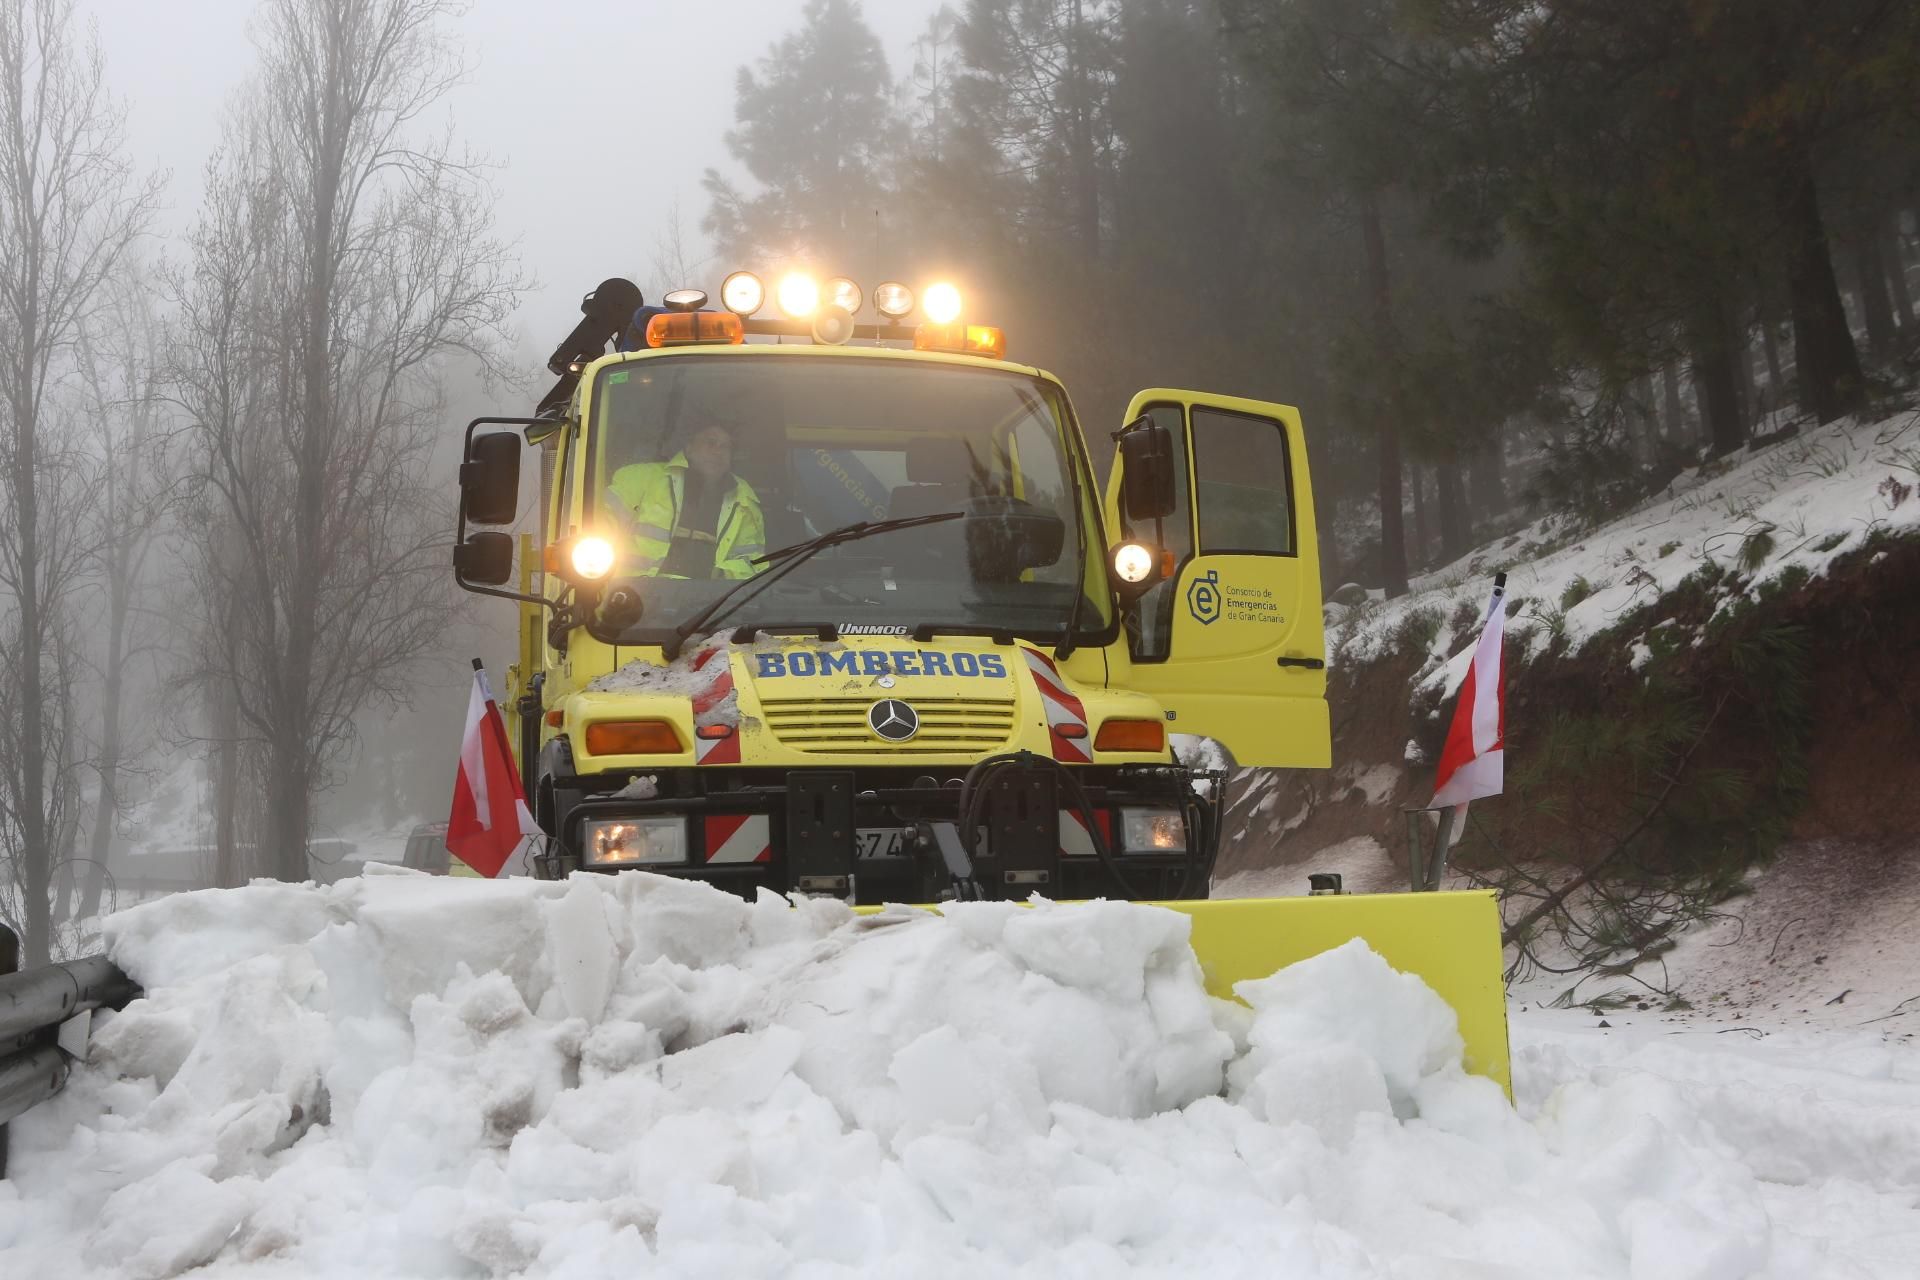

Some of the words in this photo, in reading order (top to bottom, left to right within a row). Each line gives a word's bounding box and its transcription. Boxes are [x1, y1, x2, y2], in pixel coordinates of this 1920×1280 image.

[1226, 586, 1261, 598] Consorcio
[1263, 588, 1272, 598] de
[1227, 599, 1277, 611] Emergencias
[1227, 611, 1237, 620] de
[1239, 611, 1256, 621] Gran
[1258, 613, 1285, 624] Canaria
[755, 651, 1007, 678] BOMBEROS
